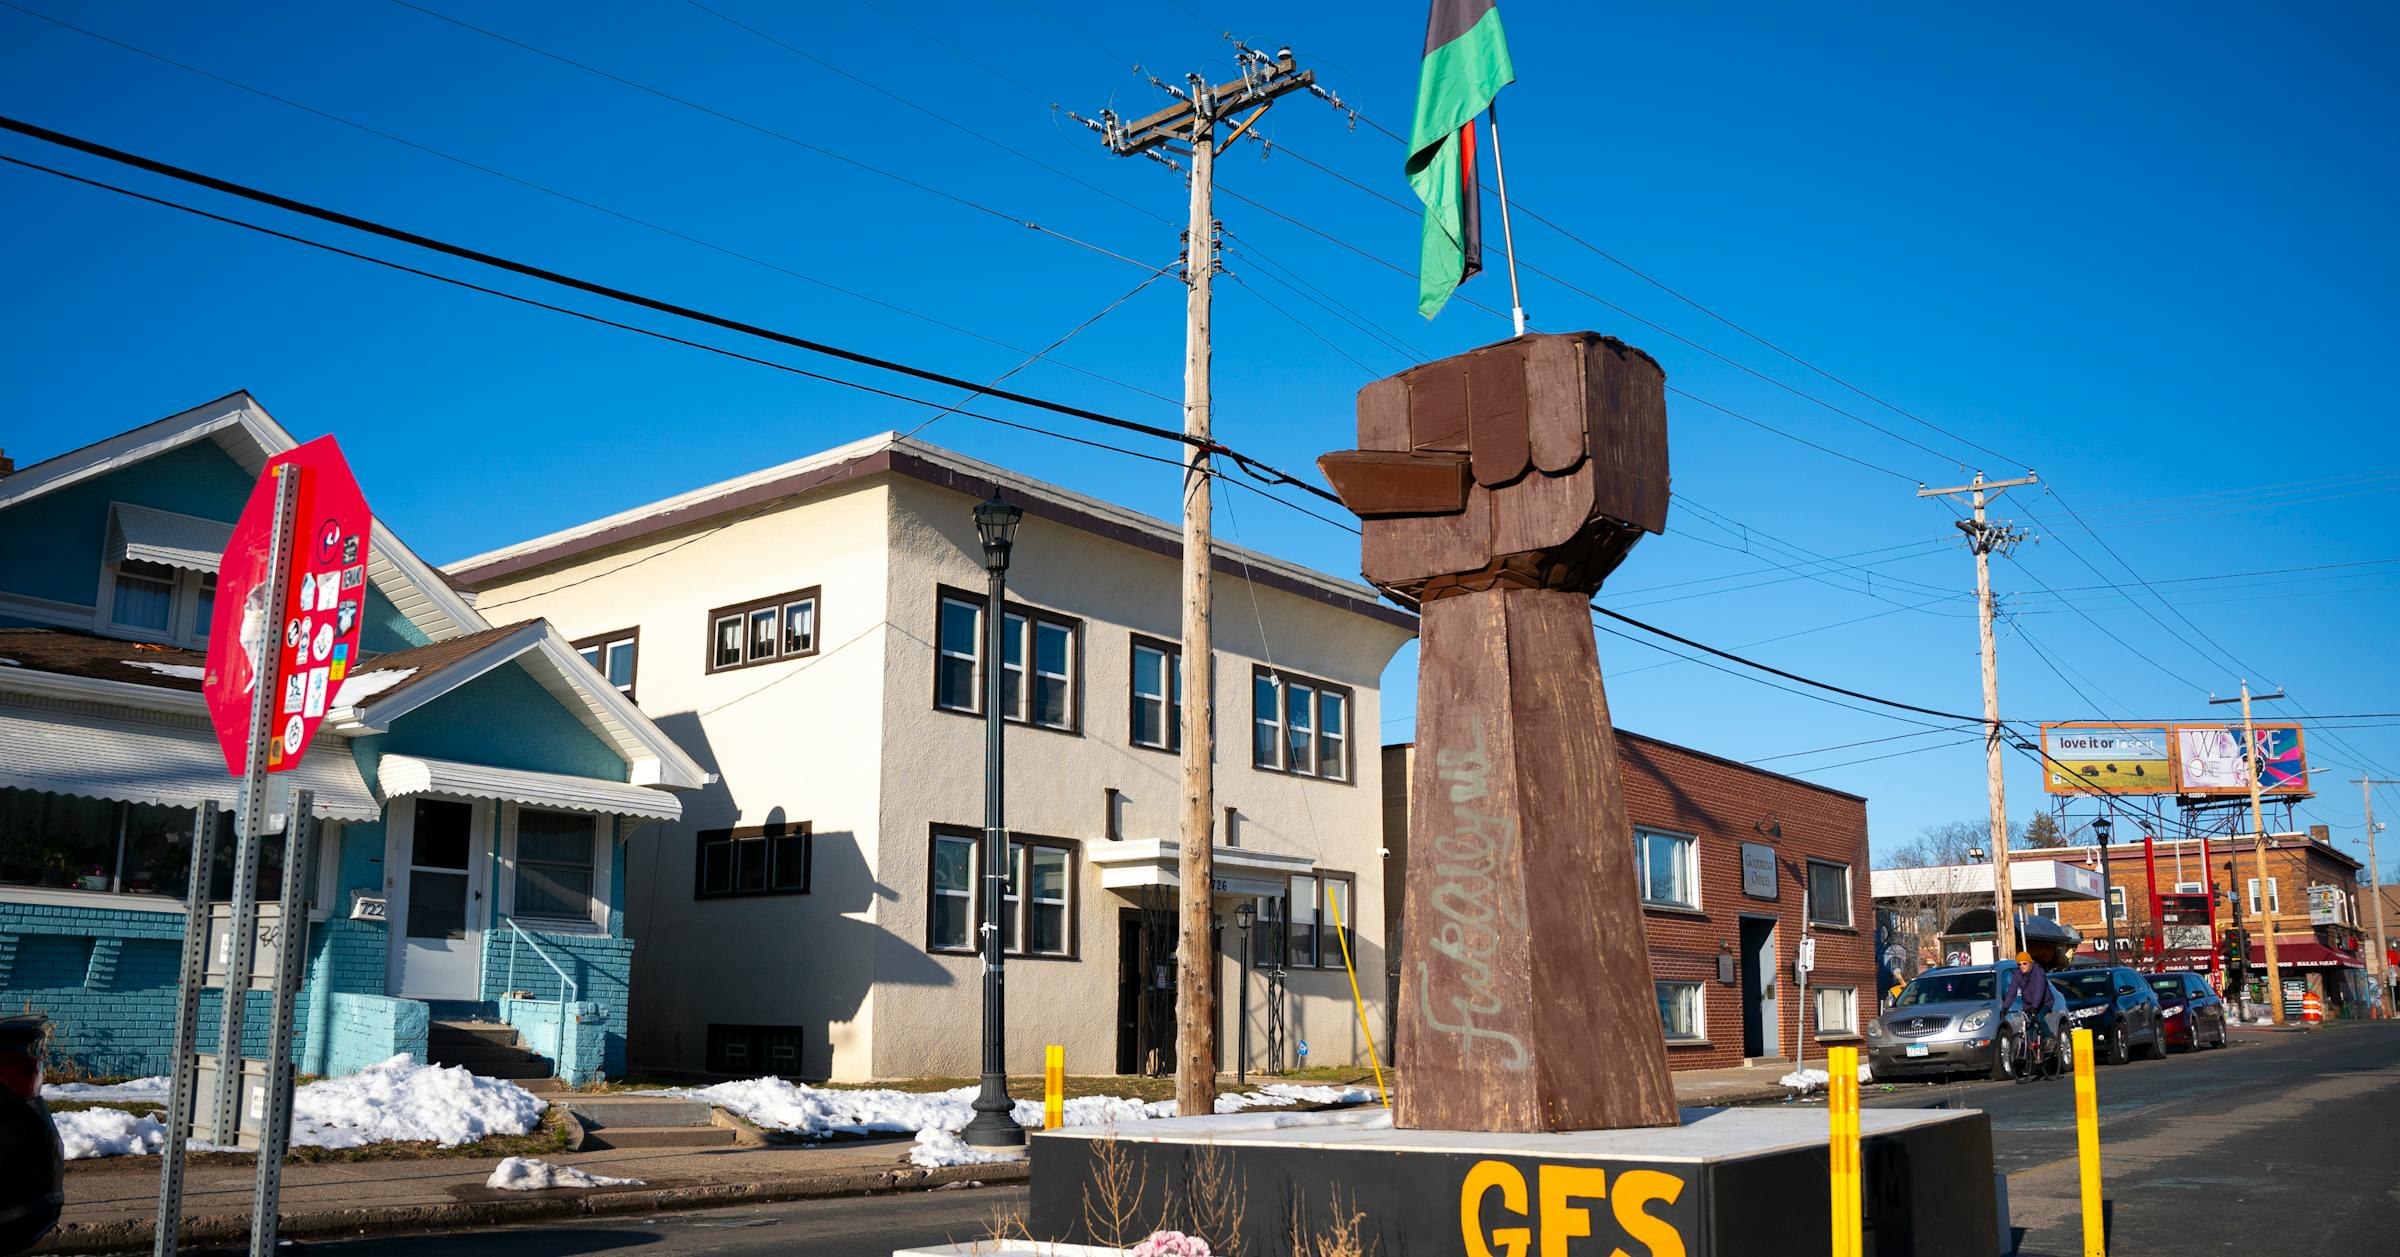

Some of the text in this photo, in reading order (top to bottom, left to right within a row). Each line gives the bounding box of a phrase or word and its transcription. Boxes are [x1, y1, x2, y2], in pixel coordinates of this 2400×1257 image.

[2060, 737, 2087, 749] love
[2089, 737, 2099, 749] it
[2101, 739, 2114, 749] or
[2116, 737, 2142, 749] lose
[2190, 730, 2232, 759] WE
[360, 902, 385, 917] 722
